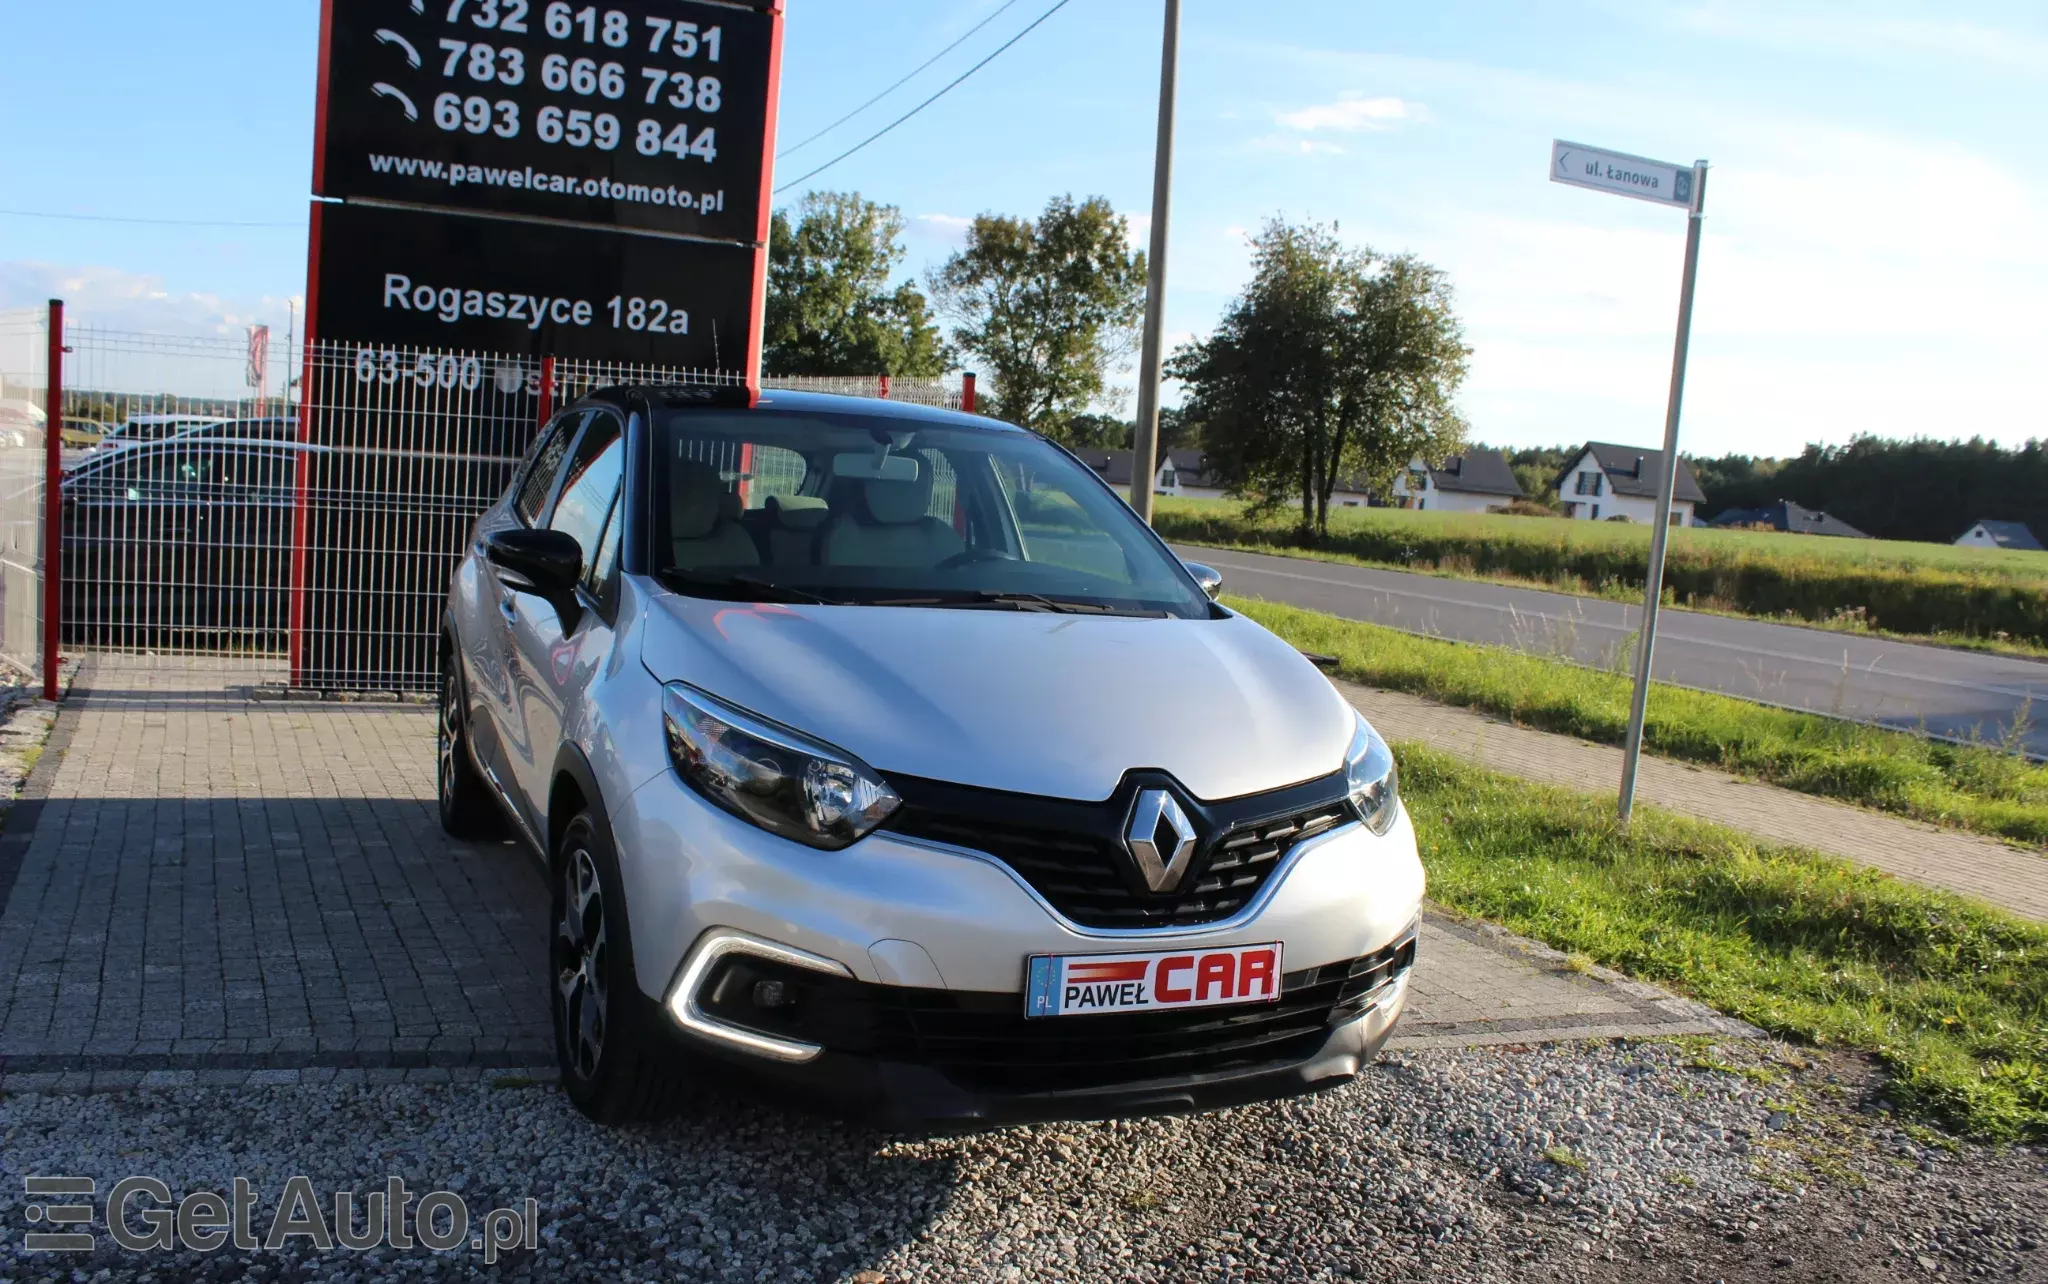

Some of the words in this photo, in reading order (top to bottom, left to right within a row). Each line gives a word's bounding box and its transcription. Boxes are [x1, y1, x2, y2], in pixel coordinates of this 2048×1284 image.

[544, 1, 629, 48] 618
[645, 16, 722, 62] 751
[438, 38, 525, 86] 783
[541, 54, 626, 99] 666
[641, 67, 722, 113] 738
[433, 92, 520, 139] 693
[536, 106, 621, 151] 659
[635, 119, 717, 163] 844
[368, 152, 725, 215] www.pawelcar.otomoto.pl
[1585, 160, 1603, 177] ul.
[1606, 163, 1660, 189] Łanowa
[383, 272, 593, 330] Rogaszyce
[606, 295, 690, 336] 182a
[355, 348, 481, 392] 63-500
[1036, 995, 1053, 1009] PL
[1064, 982, 1150, 1010] PAWEŁ
[1153, 949, 1277, 1004] CAR
